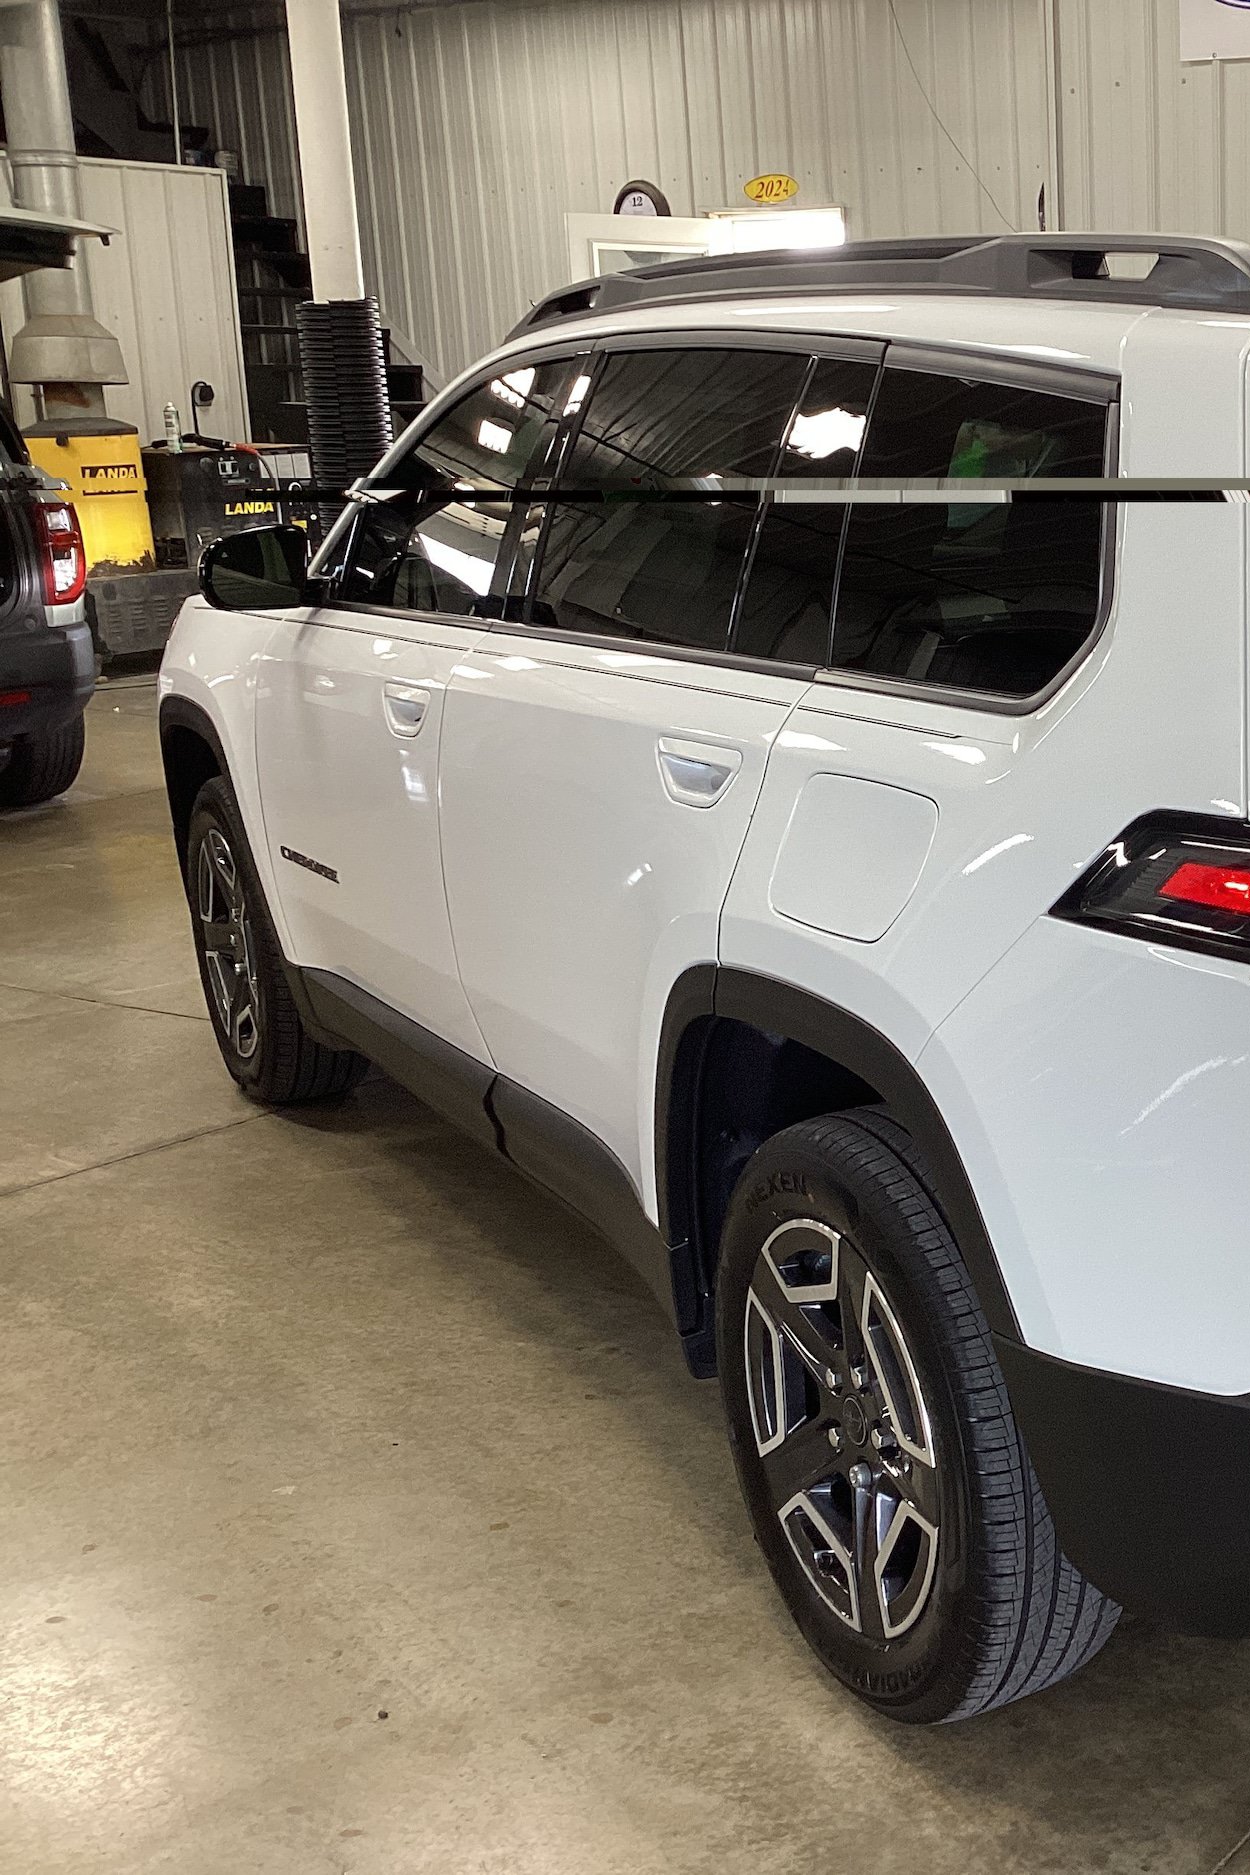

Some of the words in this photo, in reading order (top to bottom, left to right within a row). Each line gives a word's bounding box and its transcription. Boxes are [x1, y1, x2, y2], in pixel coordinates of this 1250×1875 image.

[755, 179, 790, 198] 2024
[632, 195, 644, 207] 12
[225, 502, 274, 515] LANDA
